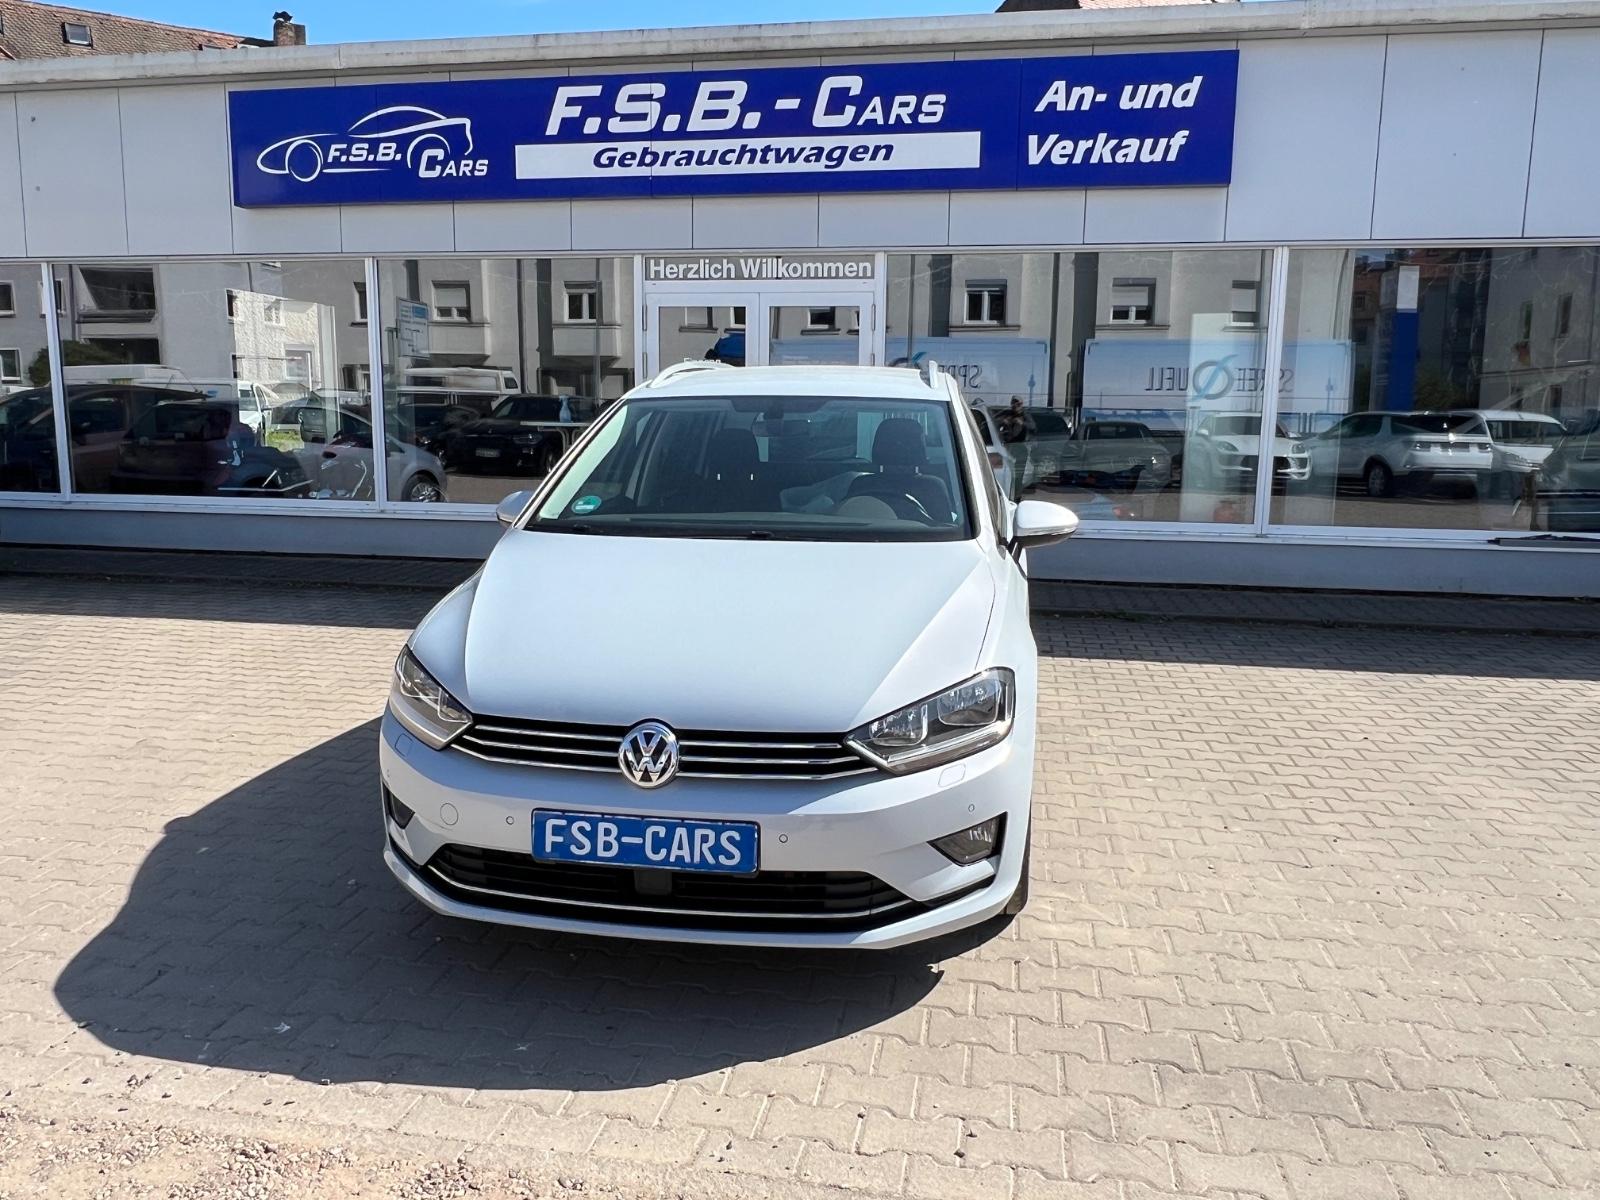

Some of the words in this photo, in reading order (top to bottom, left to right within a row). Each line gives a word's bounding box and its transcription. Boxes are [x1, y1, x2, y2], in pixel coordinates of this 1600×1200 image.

[1035, 80, 1108, 112] An-
[1119, 75, 1203, 110] und
[327, 143, 402, 164] F.S.B.
[593, 144, 894, 170] Gebrauchtwagen
[1028, 130, 1190, 164] Verkauf
[650, 259, 736, 279] Herzlich
[740, 258, 872, 278] Willkommen
[545, 818, 742, 866] FSB-CARS
